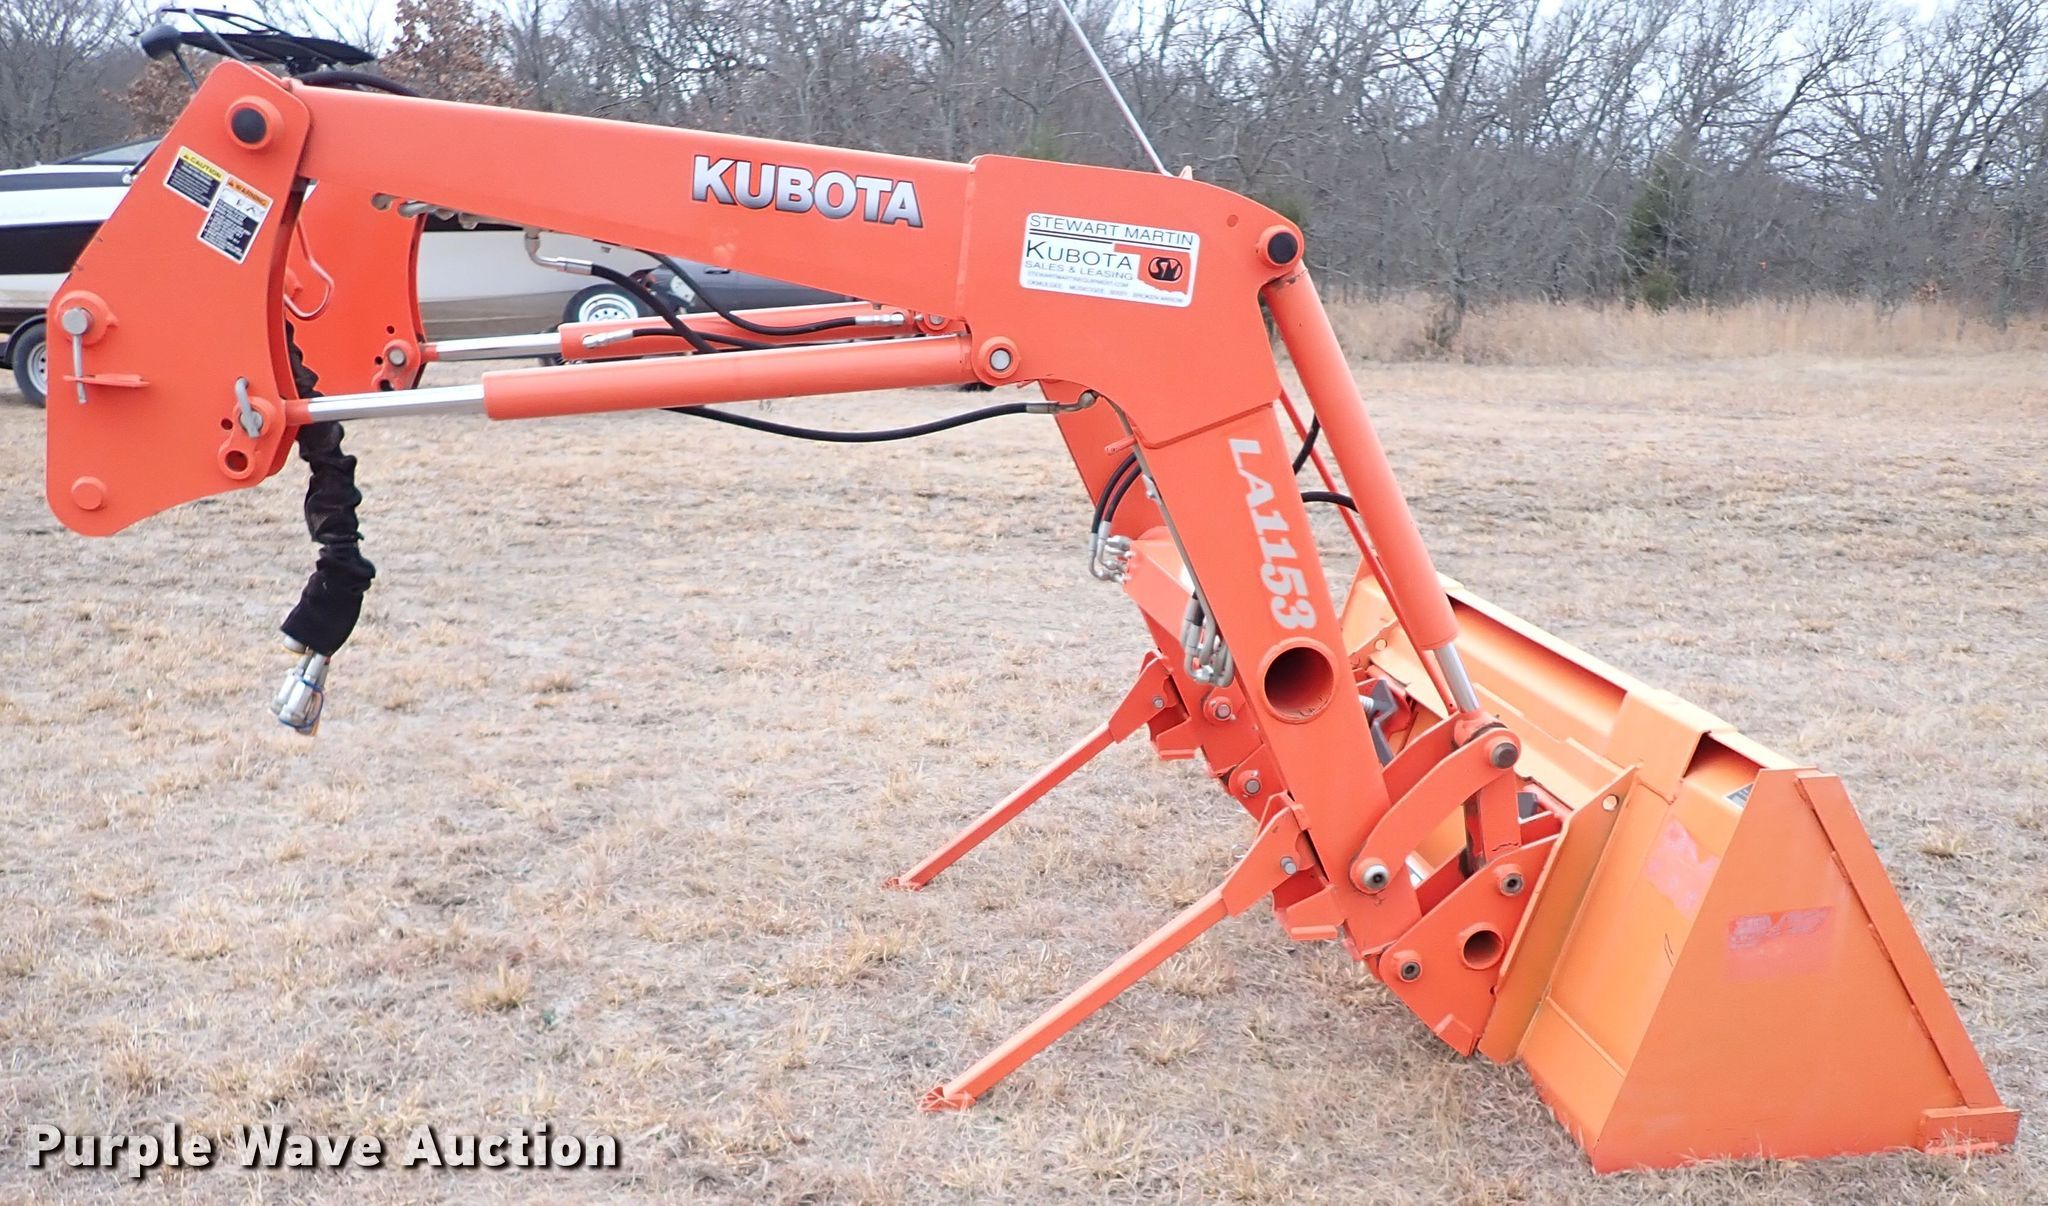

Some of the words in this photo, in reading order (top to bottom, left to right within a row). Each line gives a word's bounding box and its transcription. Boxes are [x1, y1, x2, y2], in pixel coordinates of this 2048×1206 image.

[190, 156, 222, 179] CAUTION
[236, 183, 267, 207] WARNING
[692, 155, 923, 228] KUBOTA
[1030, 215, 1119, 236] STEWART
[1124, 227, 1193, 245] MARTIN
[1026, 239, 1132, 270] KUBOTA
[1025, 260, 1065, 273] SALES
[1068, 266, 1076, 274] &
[1080, 267, 1134, 281] LEASING
[1228, 438, 1317, 630] LA1153
